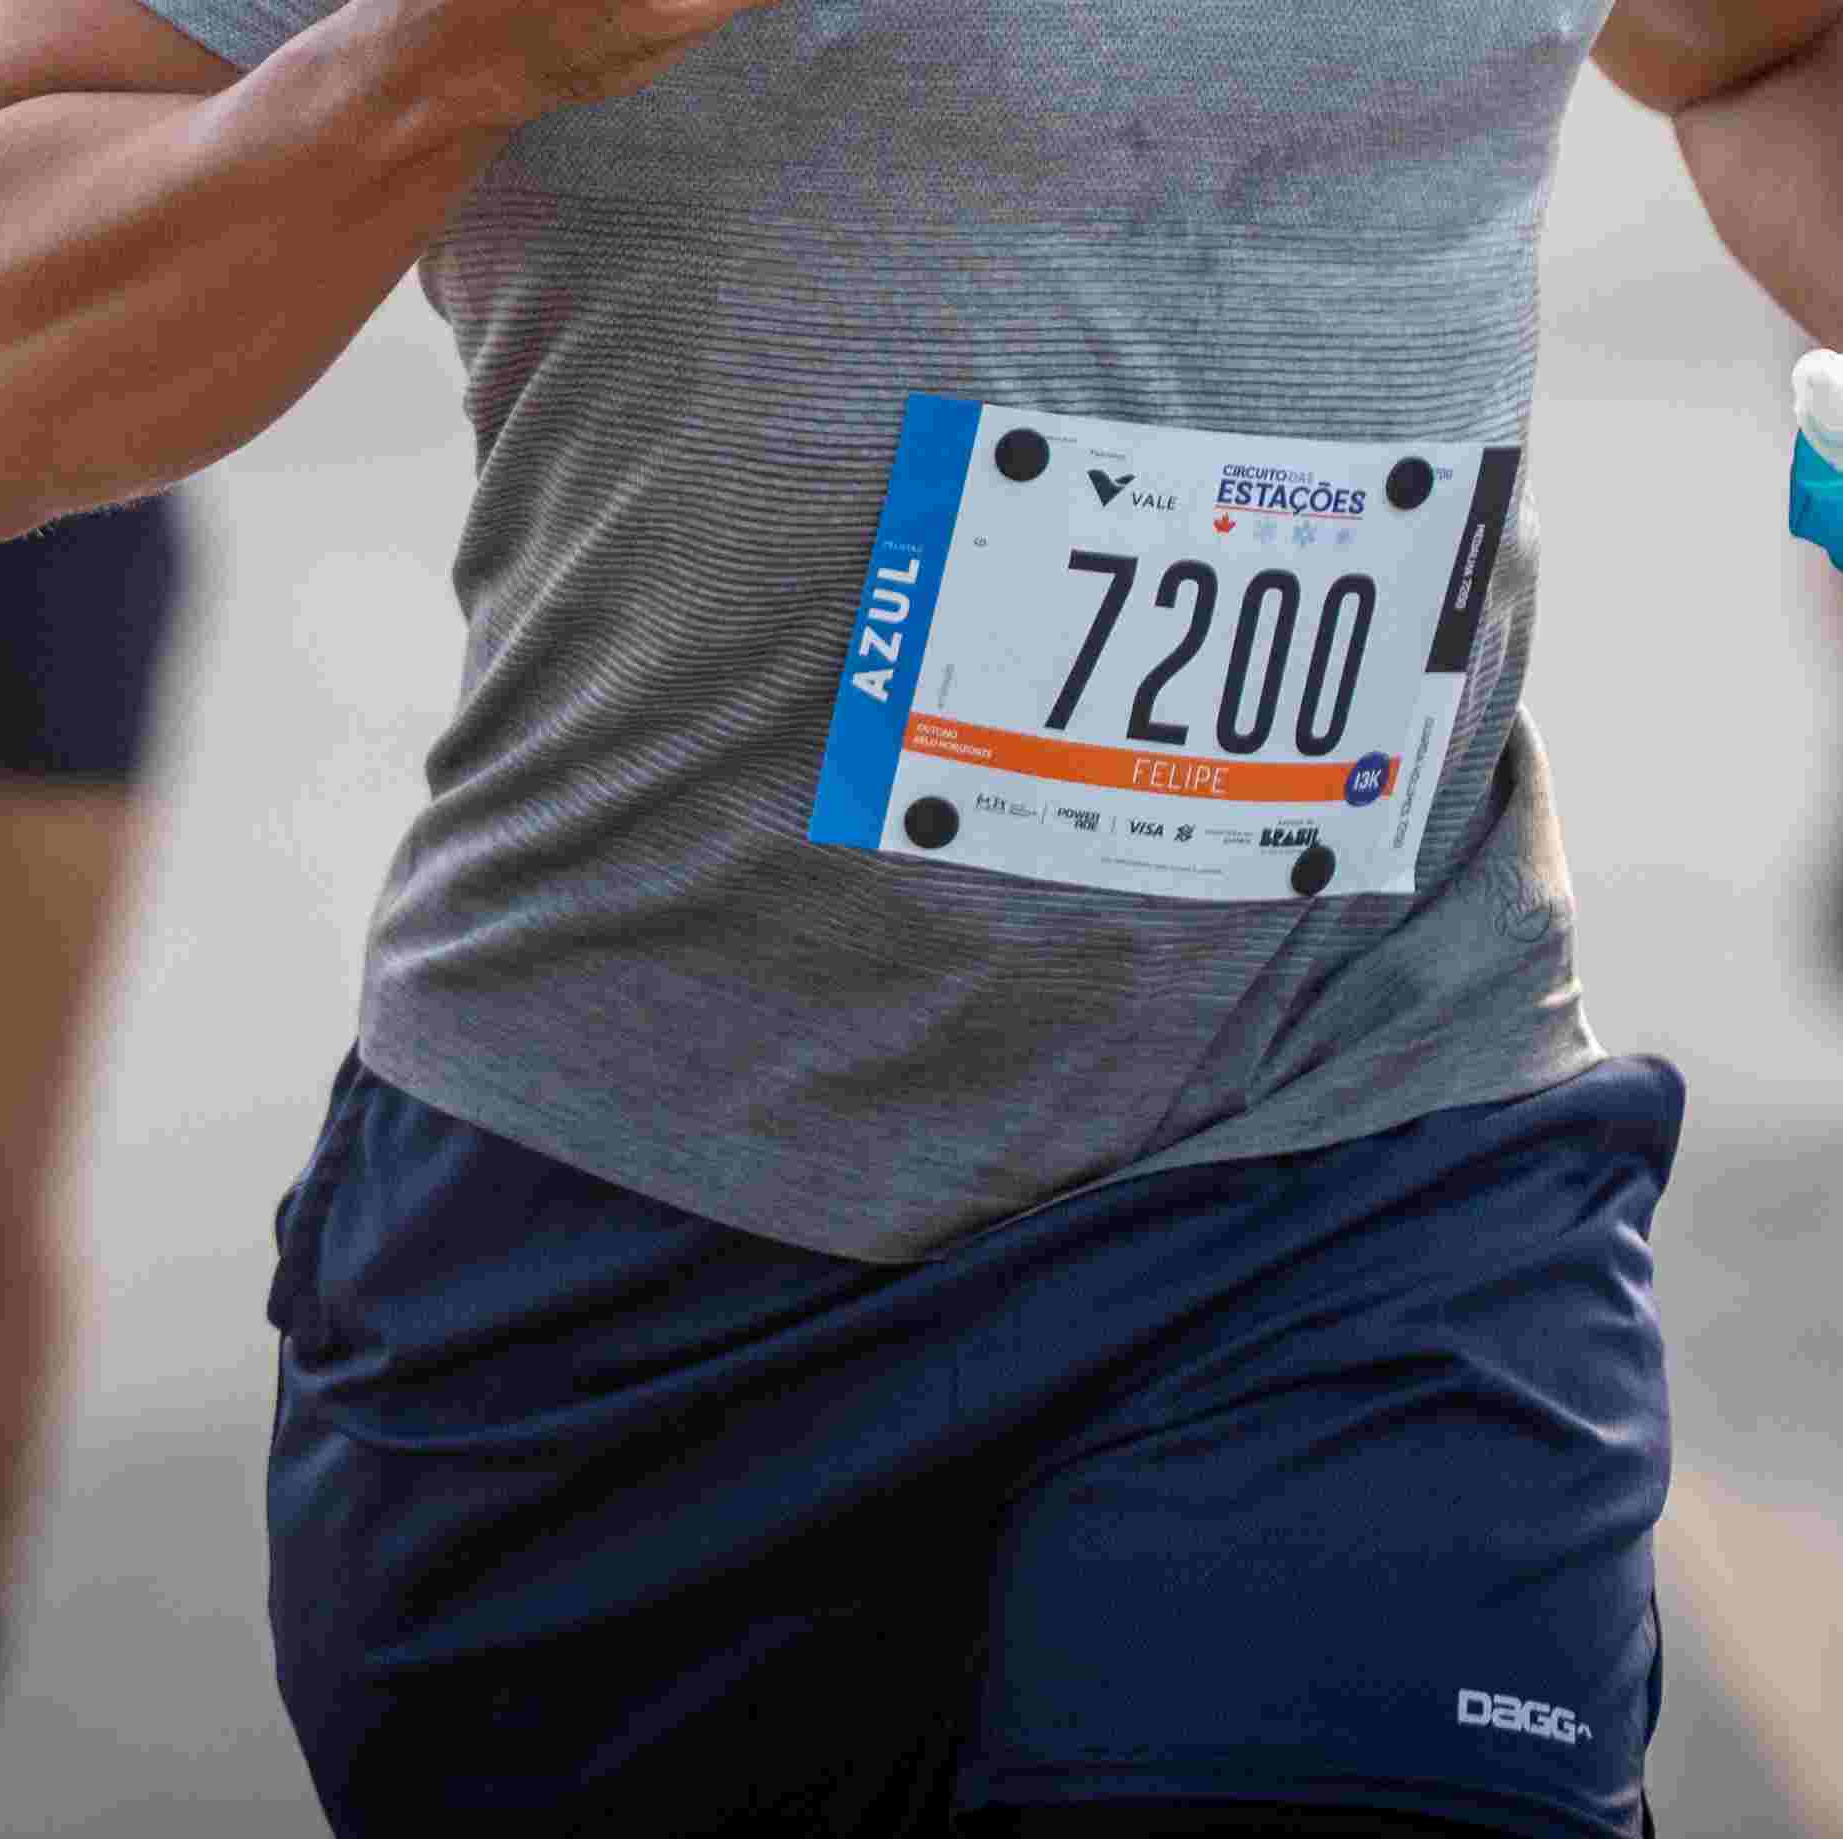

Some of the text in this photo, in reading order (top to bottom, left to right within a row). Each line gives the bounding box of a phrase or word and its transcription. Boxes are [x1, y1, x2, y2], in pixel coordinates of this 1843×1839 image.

[1222, 464, 1287, 482] CIRCUITO
[1131, 492, 1180, 512] VALE
[1216, 478, 1367, 515] ESTAÇÕES
[851, 557, 921, 704] AZUL
[1044, 549, 1378, 757] 7200
[1131, 757, 1231, 795] FELIPE
[1129, 820, 1164, 837] VISA
